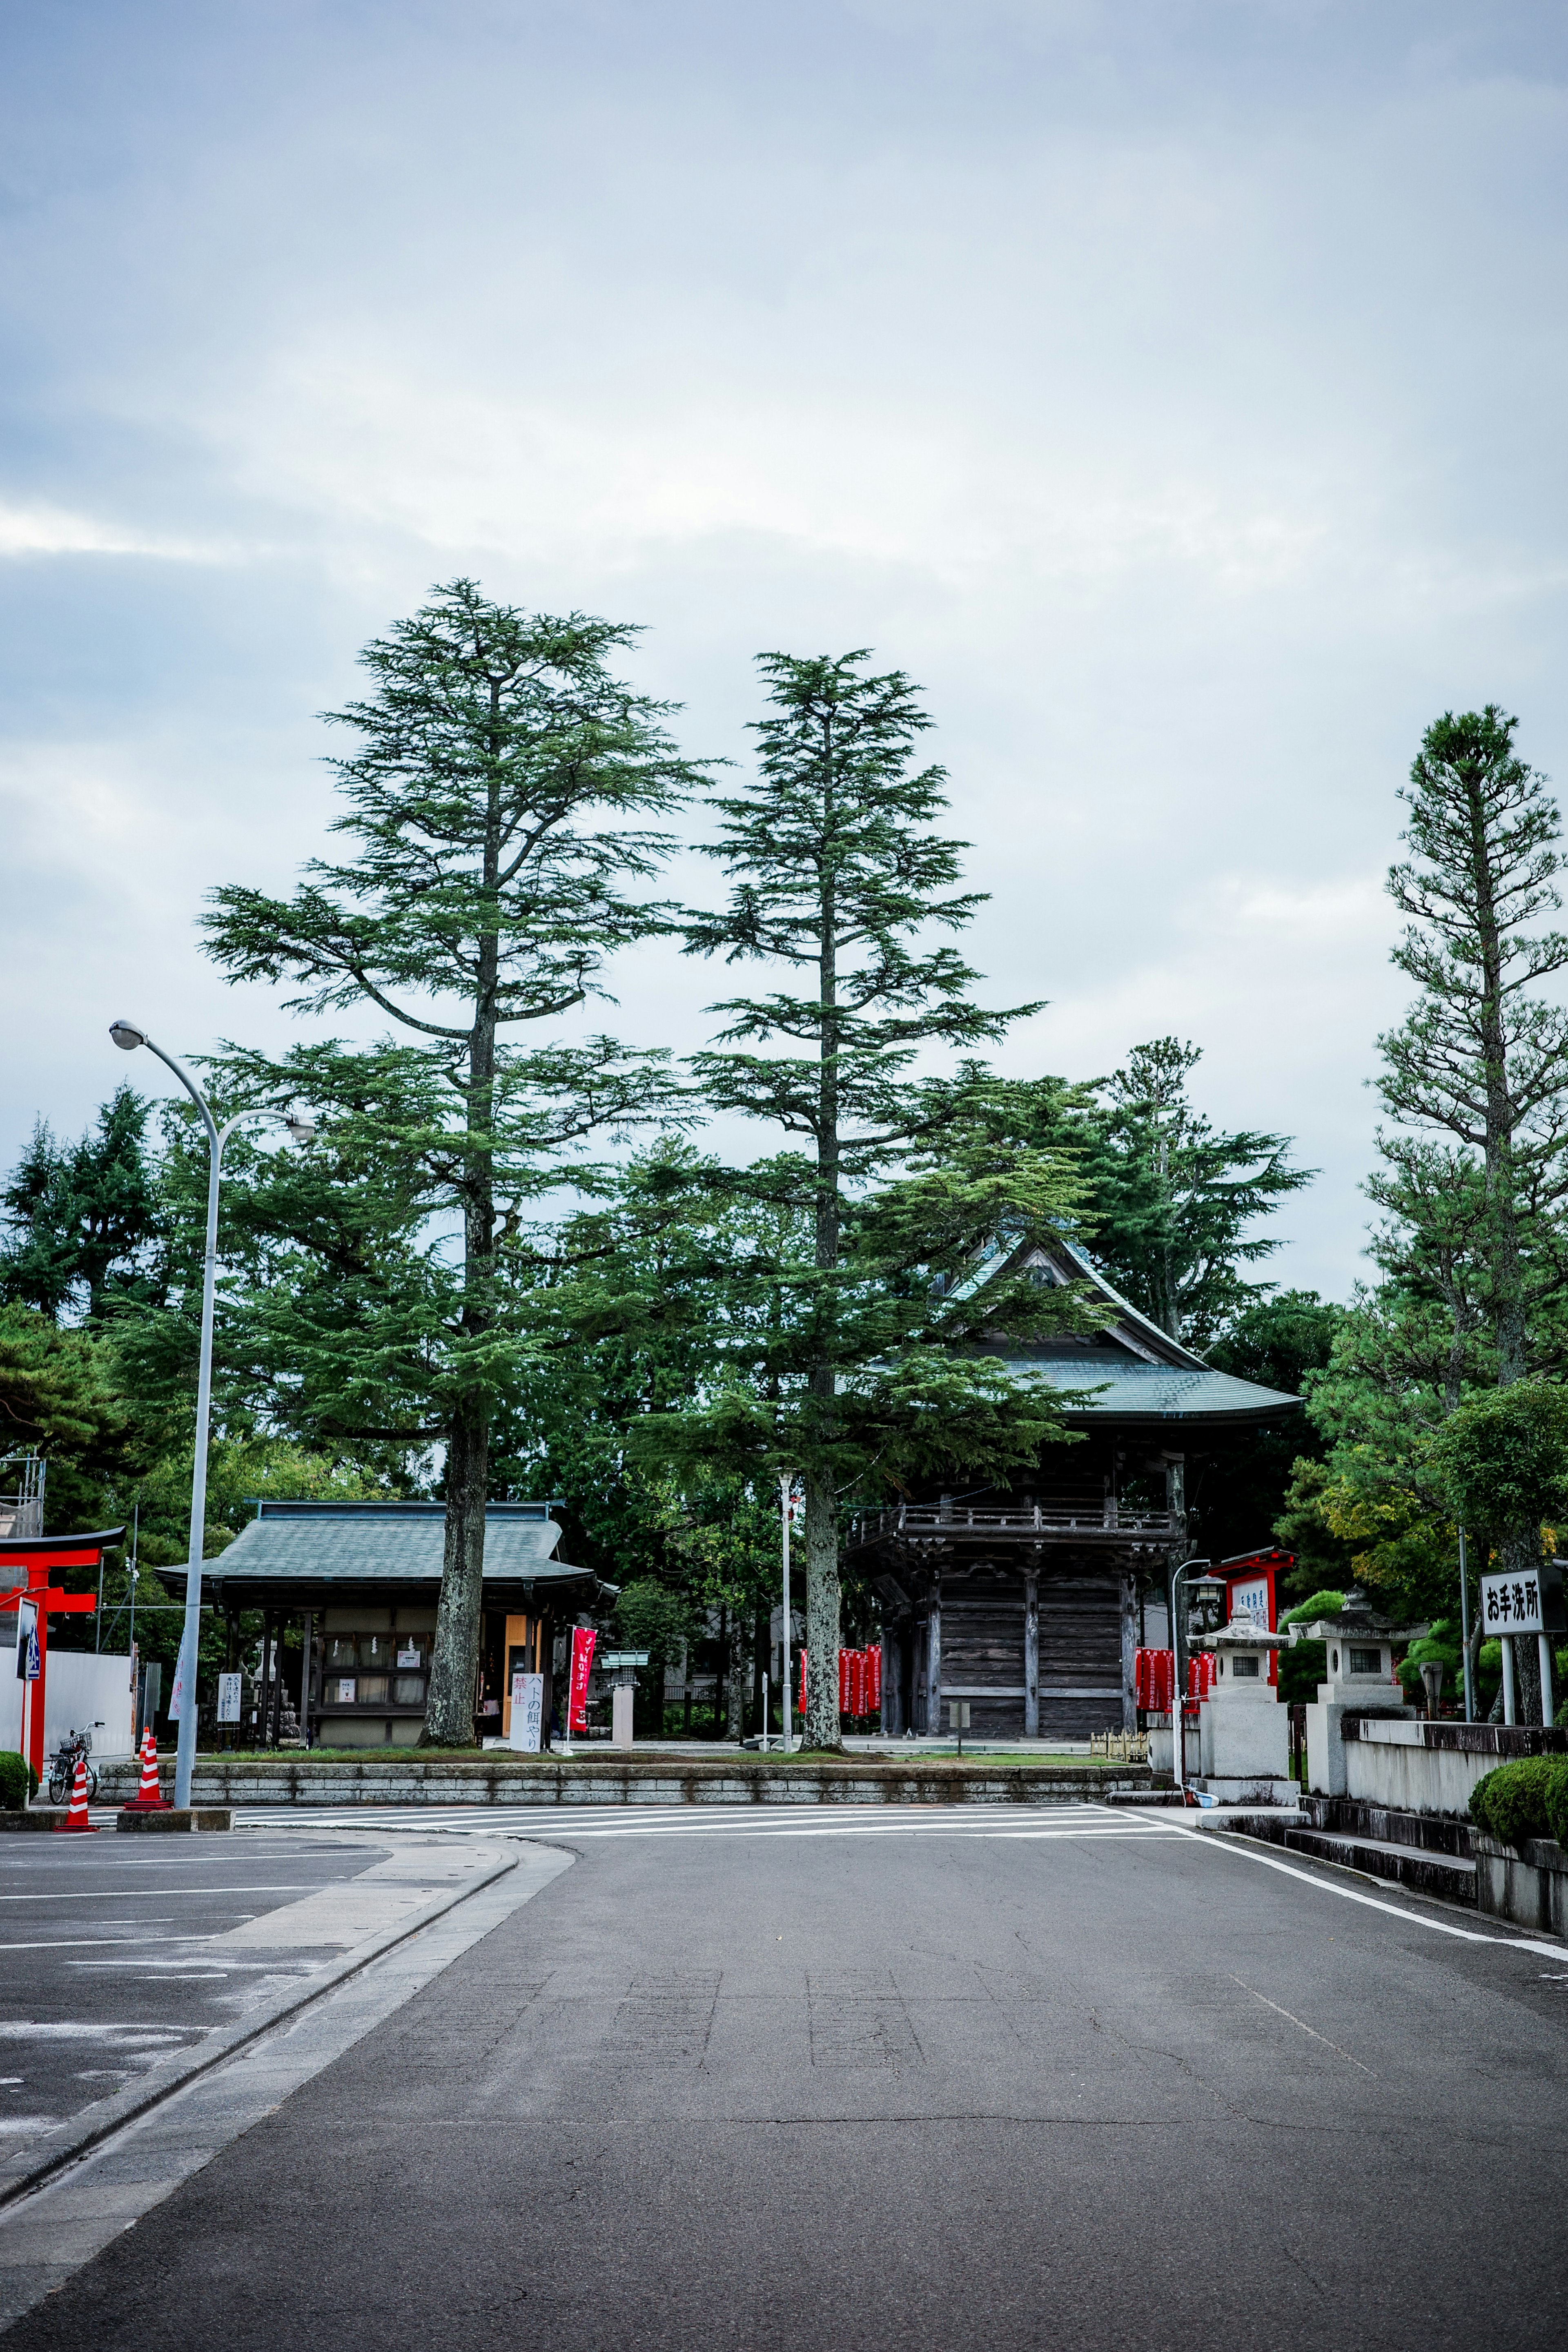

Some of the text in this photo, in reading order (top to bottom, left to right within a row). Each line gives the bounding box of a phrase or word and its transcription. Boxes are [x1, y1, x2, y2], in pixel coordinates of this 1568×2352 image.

[1487, 1579, 1538, 1622] お手洗所
[512, 1676, 527, 1704] 禁止
[526, 1677, 541, 1751] ハトの餌やり
